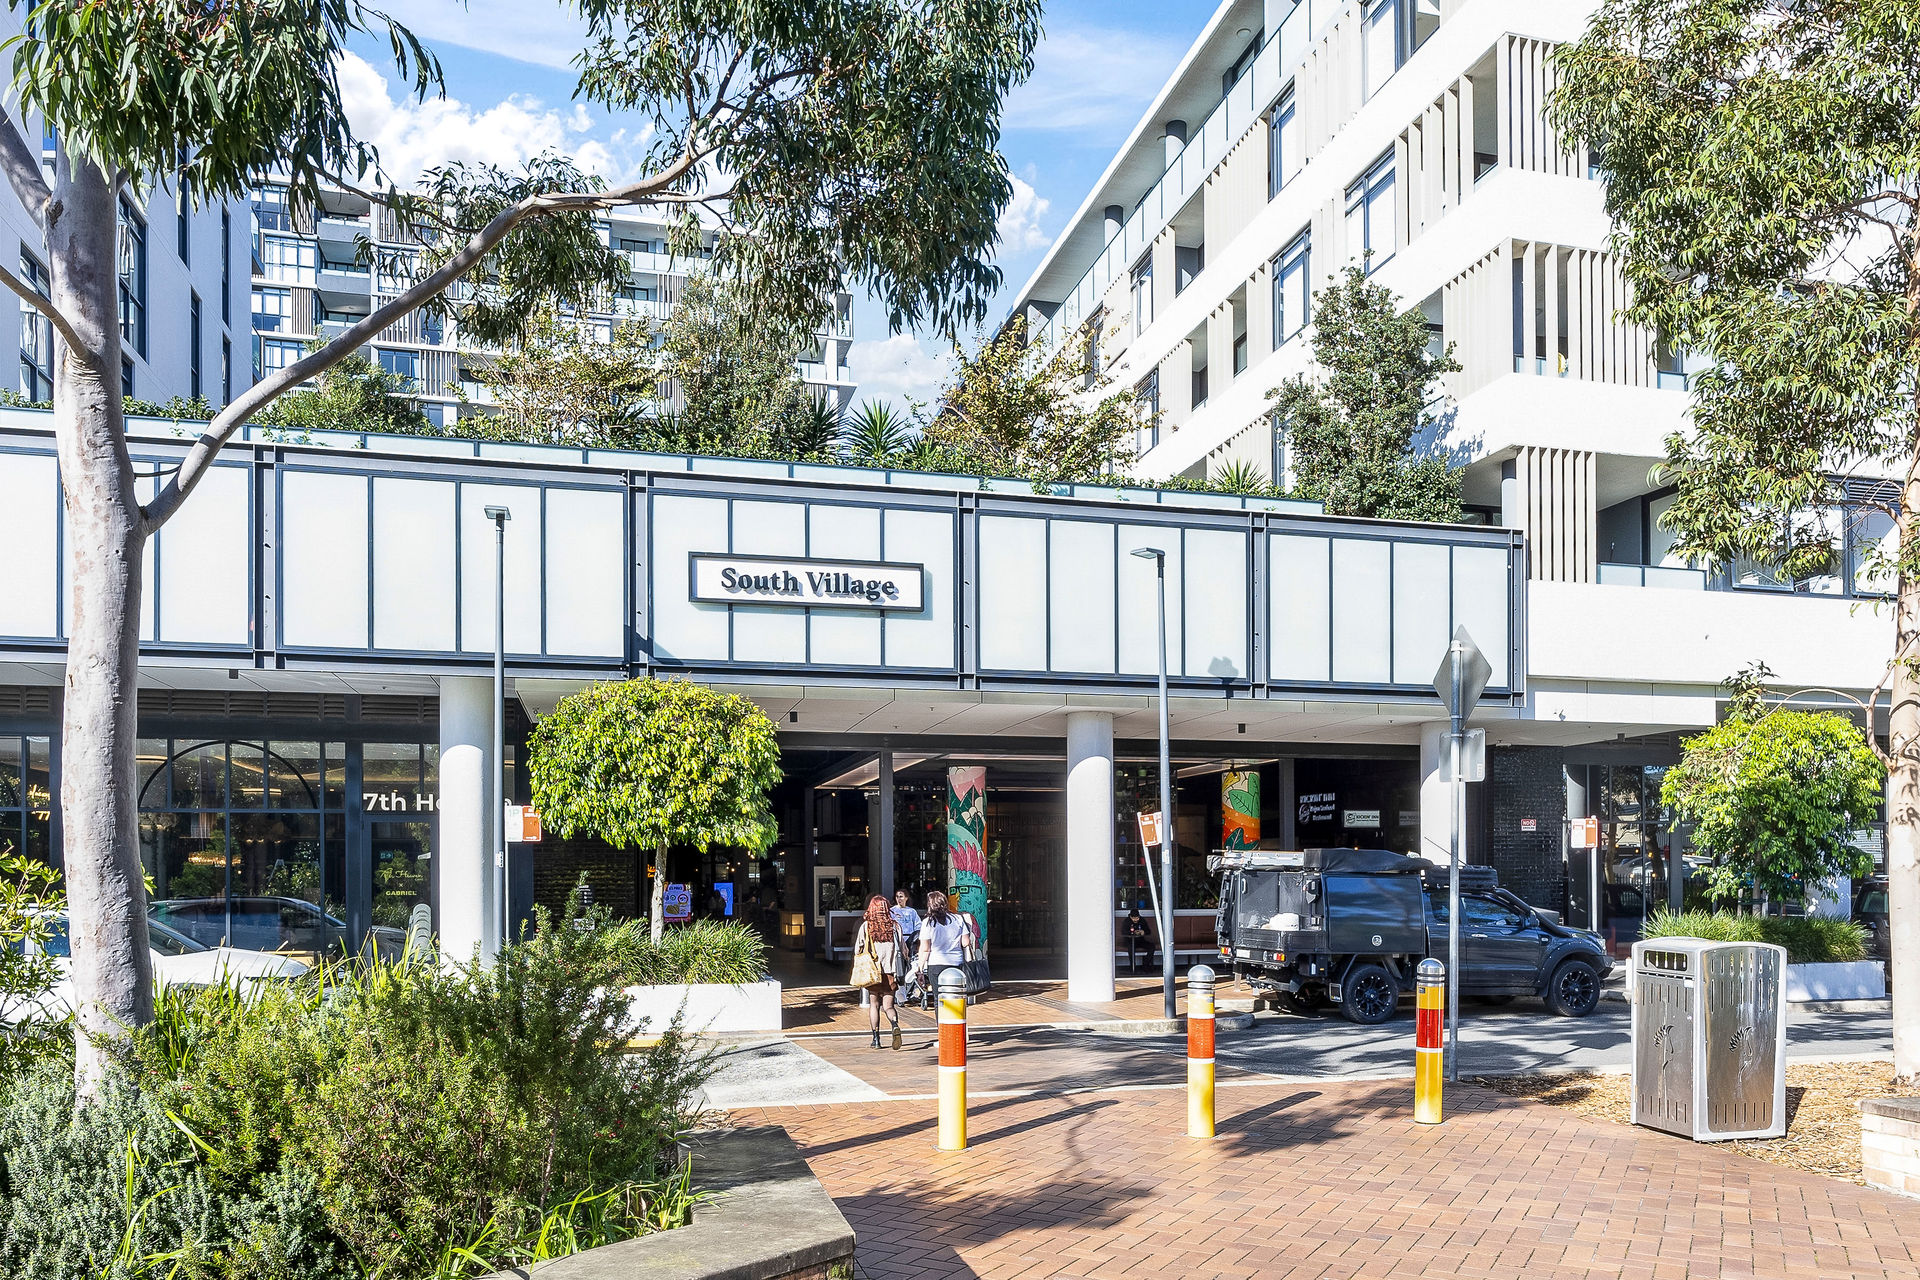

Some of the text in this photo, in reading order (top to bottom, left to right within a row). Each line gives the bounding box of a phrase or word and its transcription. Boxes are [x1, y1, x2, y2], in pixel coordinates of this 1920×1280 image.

[721, 567, 895, 601] South Village
[363, 792, 407, 811] 7th
